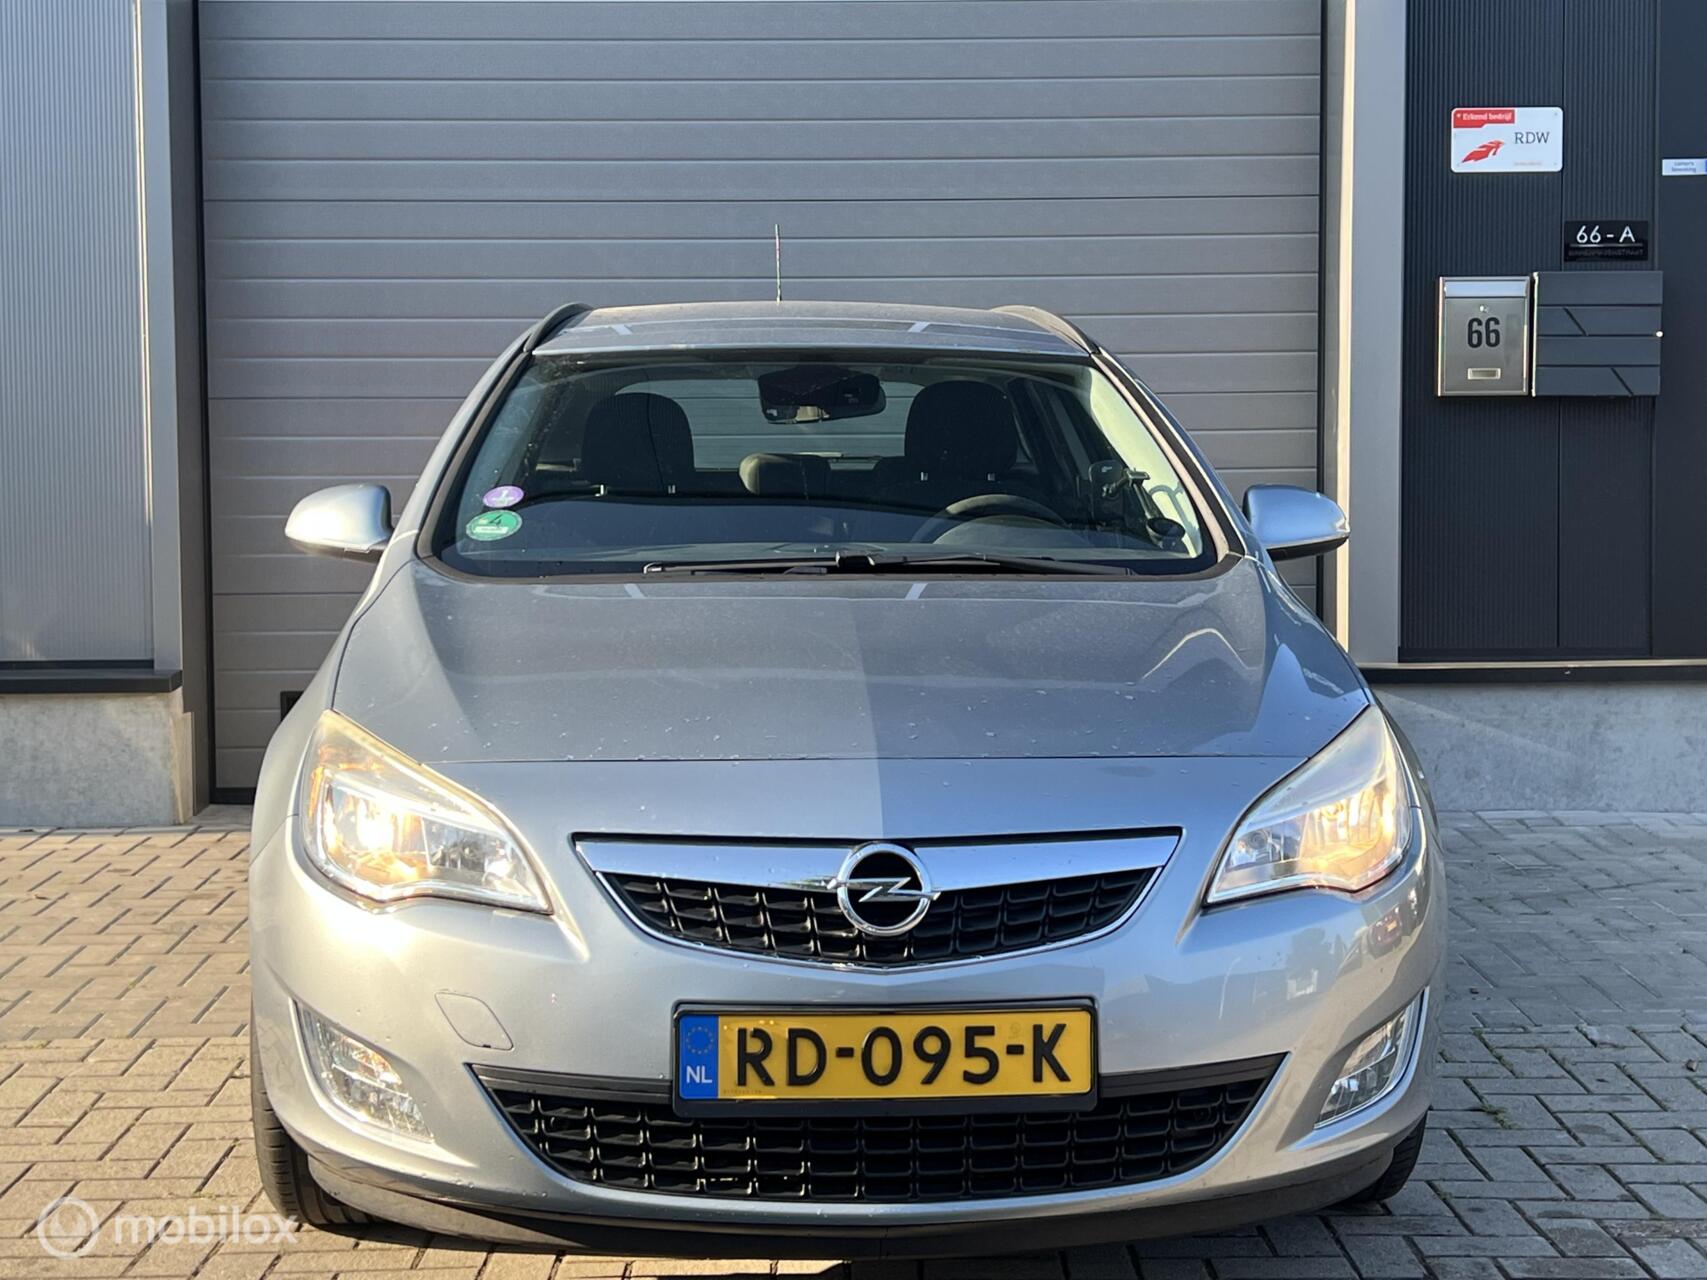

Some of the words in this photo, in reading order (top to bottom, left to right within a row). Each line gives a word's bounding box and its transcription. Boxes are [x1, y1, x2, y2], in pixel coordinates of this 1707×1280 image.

[1514, 131, 1550, 144] RDW
[1576, 225, 1602, 244] 66
[1619, 225, 1636, 243] A
[1467, 317, 1500, 348] 66
[736, 1023, 1072, 1087] RD-095-K
[686, 1065, 713, 1084] NL
